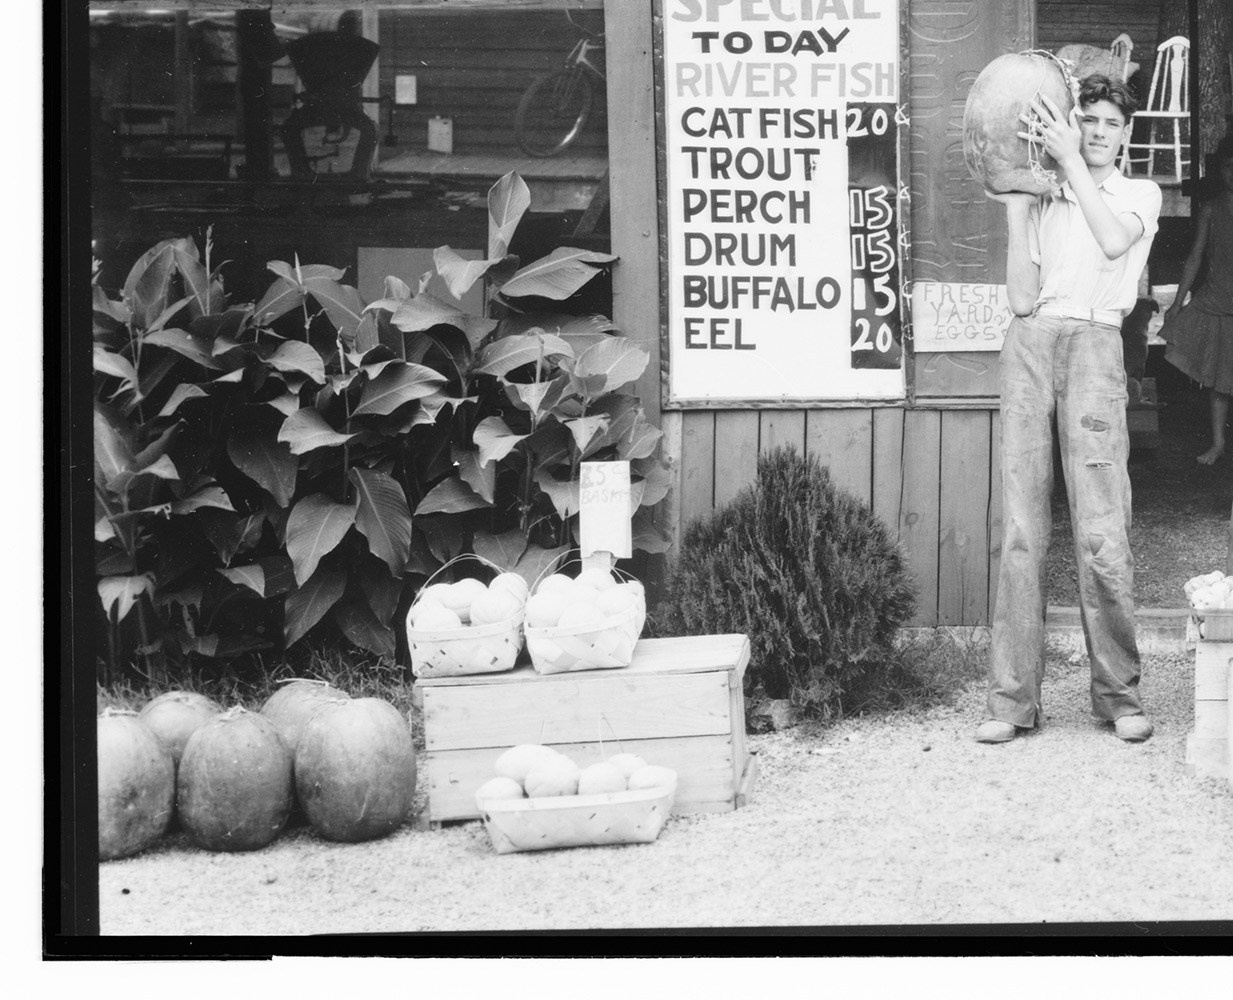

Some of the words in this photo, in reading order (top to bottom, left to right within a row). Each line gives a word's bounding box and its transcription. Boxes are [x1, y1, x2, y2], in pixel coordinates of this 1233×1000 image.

[675, 61, 798, 99] RIVER
[811, 62, 898, 98] FISH
[681, 145, 821, 182] TROUT
[681, 188, 812, 225] PERCH
[683, 231, 797, 268] DRUM
[683, 274, 843, 314] BUFFALO
[923, 283, 999, 305] FRESH
[684, 317, 758, 351] EEL
[934, 324, 997, 341] EGGS
